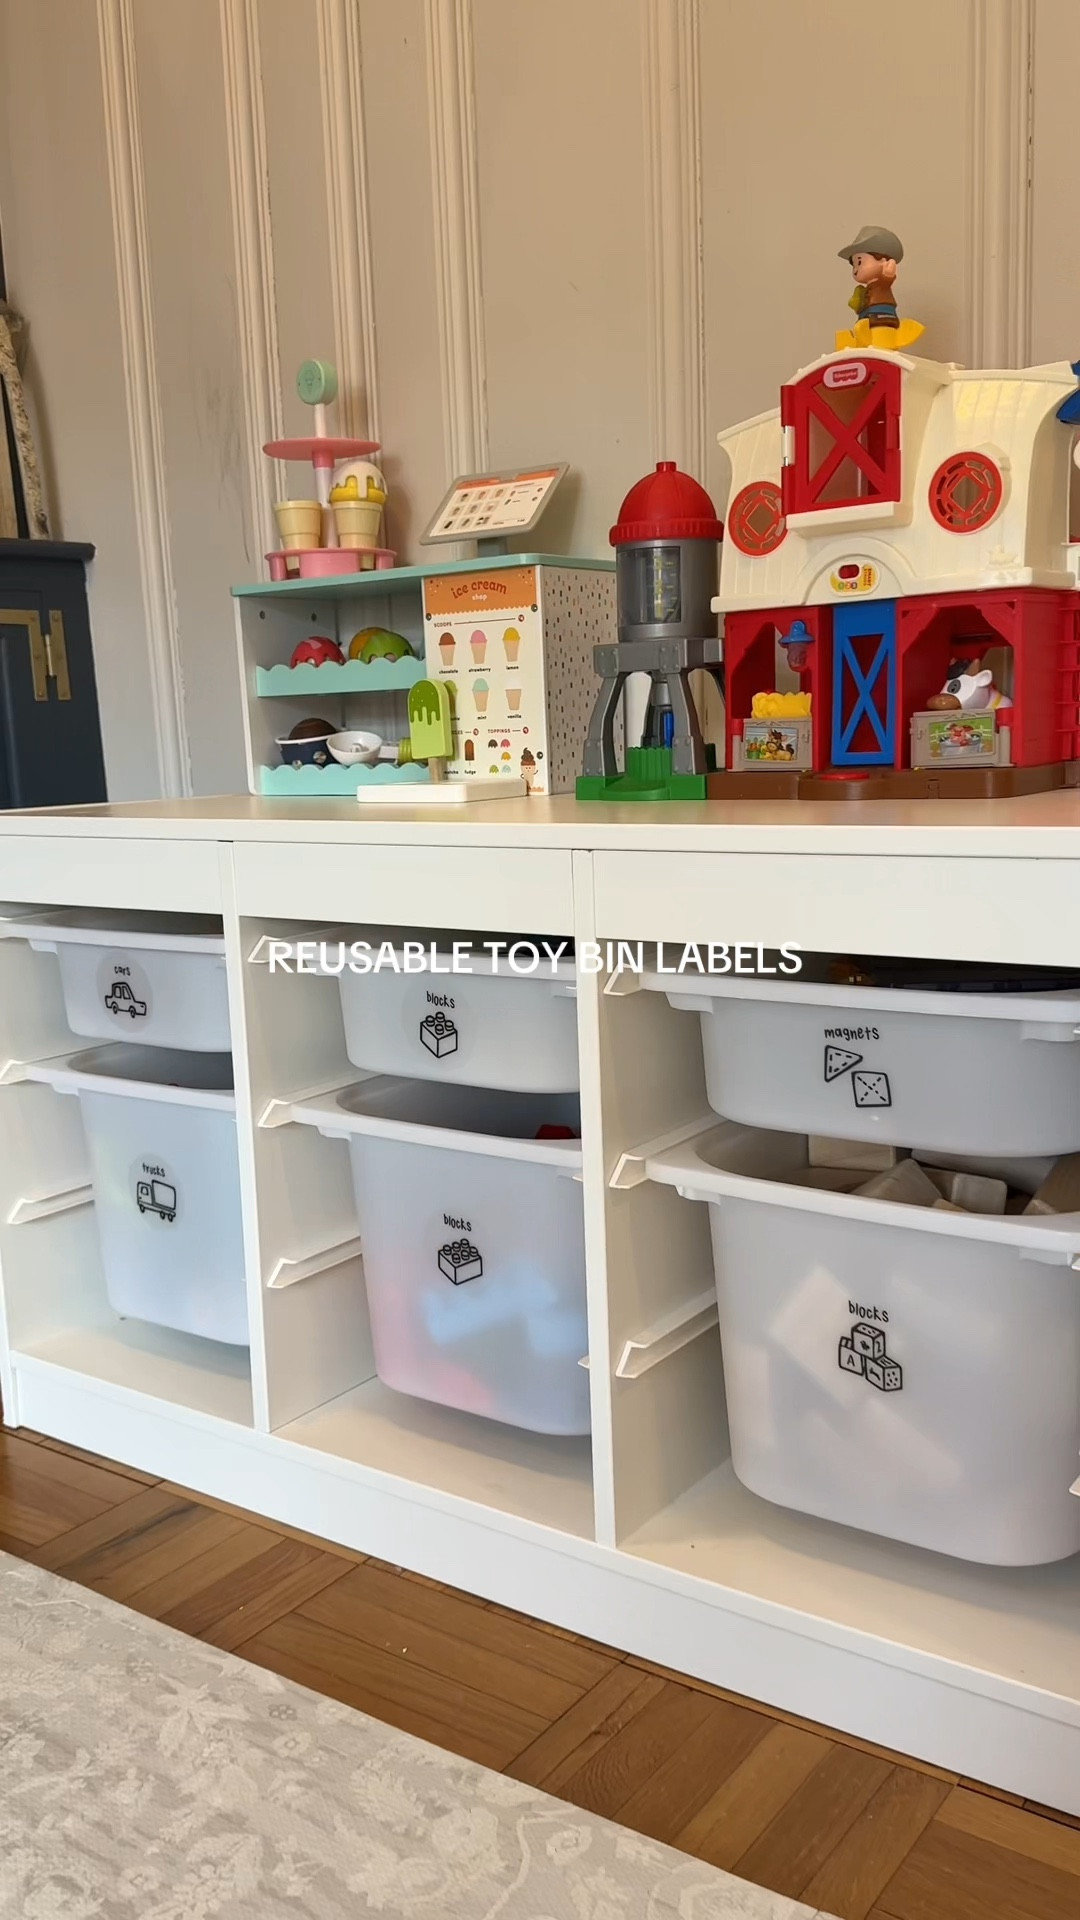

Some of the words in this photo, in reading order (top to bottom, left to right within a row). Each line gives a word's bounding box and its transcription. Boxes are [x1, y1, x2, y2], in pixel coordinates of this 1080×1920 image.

[451, 585, 469, 599] ice
[471, 581, 507, 594] cream
[114, 965, 131, 977] cars
[426, 991, 456, 1009] blocks
[824, 1026, 880, 1041] magnets
[142, 1162, 166, 1178] trucks
[443, 1213, 472, 1232] blocks
[848, 1300, 890, 1323] blocks
[846, 1354, 856, 1367] A
